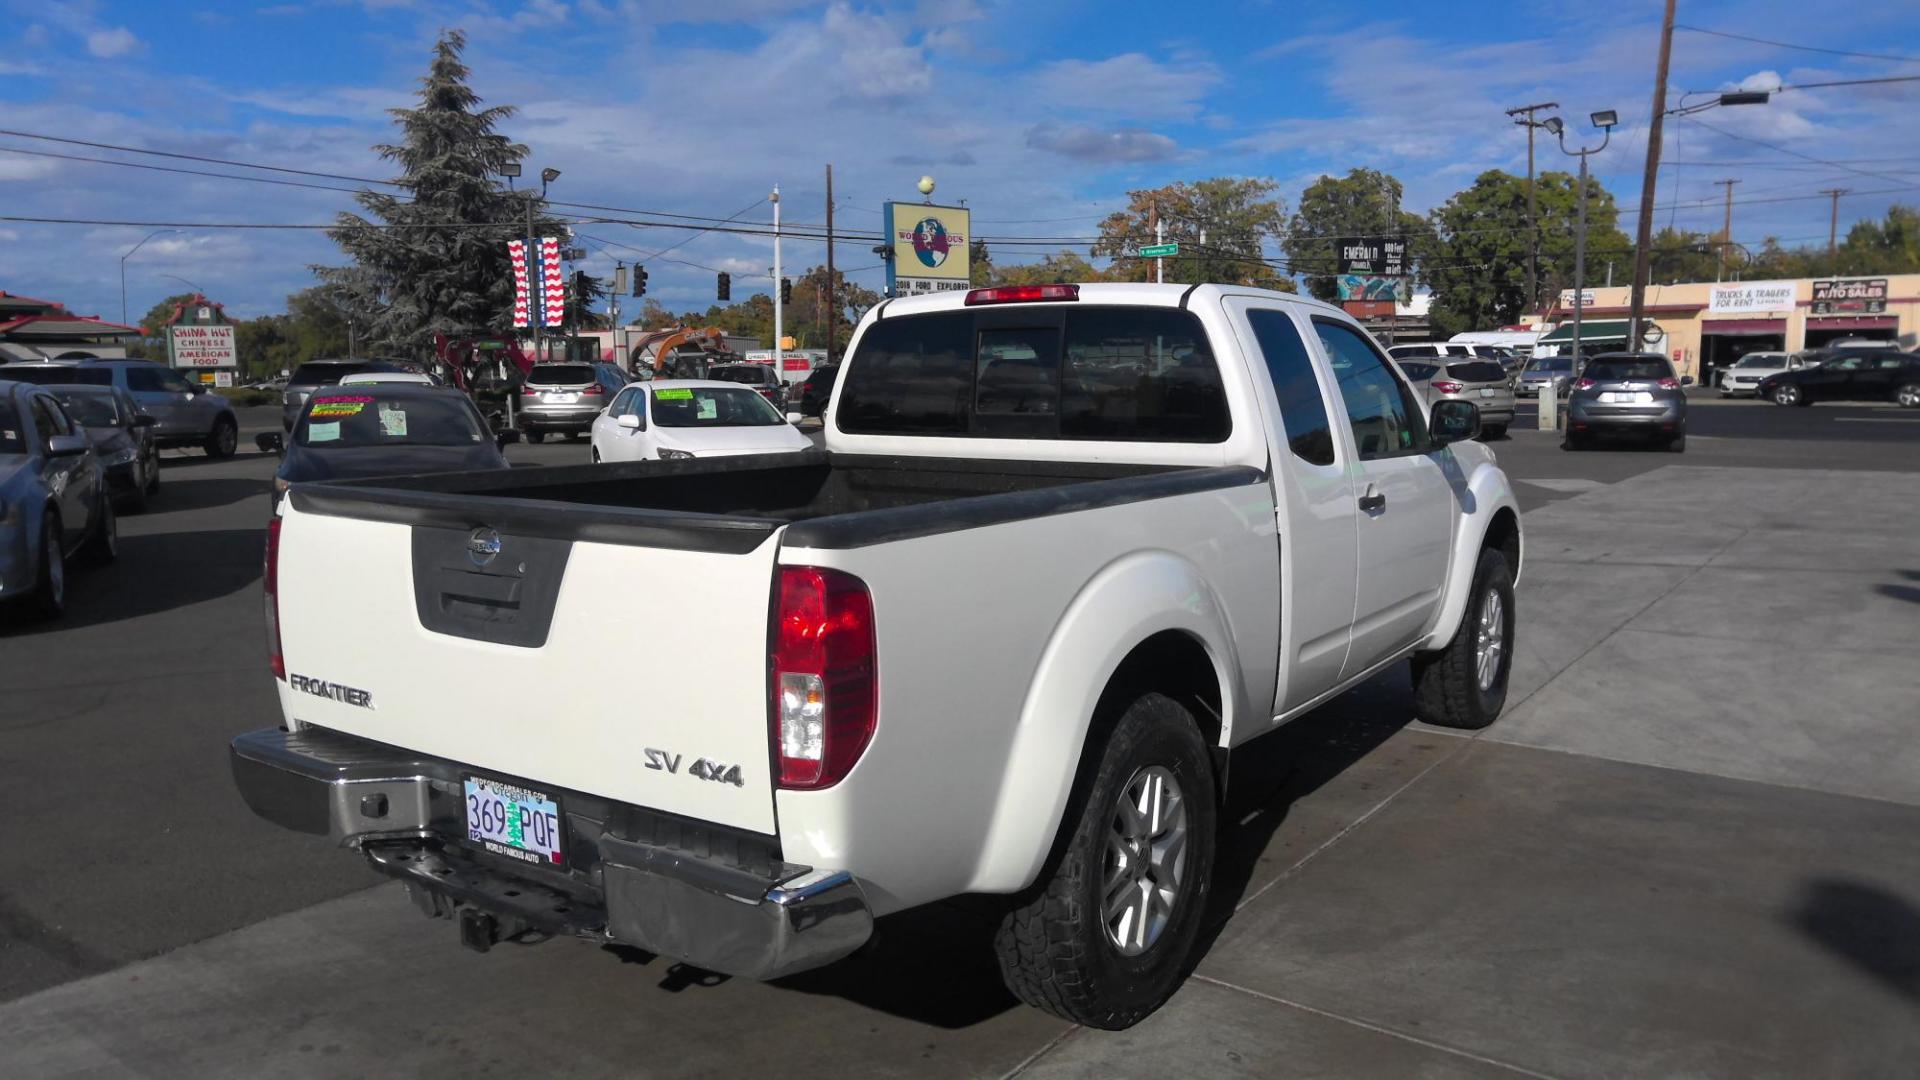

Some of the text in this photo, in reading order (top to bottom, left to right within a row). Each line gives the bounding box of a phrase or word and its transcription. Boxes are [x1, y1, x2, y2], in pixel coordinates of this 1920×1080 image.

[1344, 247, 1378, 260] EMERALD
[538, 265, 546, 321] FINANCE
[915, 282, 931, 291] FORD
[937, 282, 969, 291] EXPLORER
[1817, 288, 1883, 298] AUTO SALES
[1716, 289, 1791, 299] TRUCKS & TRAILERS
[1716, 299, 1731, 307] FOR
[1734, 299, 1753, 307] RENT
[173, 328, 231, 338] CHINA HUT
[291, 673, 375, 711] FRONTIER
[644, 747, 682, 774] SV
[468, 794, 556, 849] 369 PQF
[485, 841, 540, 864] WORLD FAMOUS AUTO
